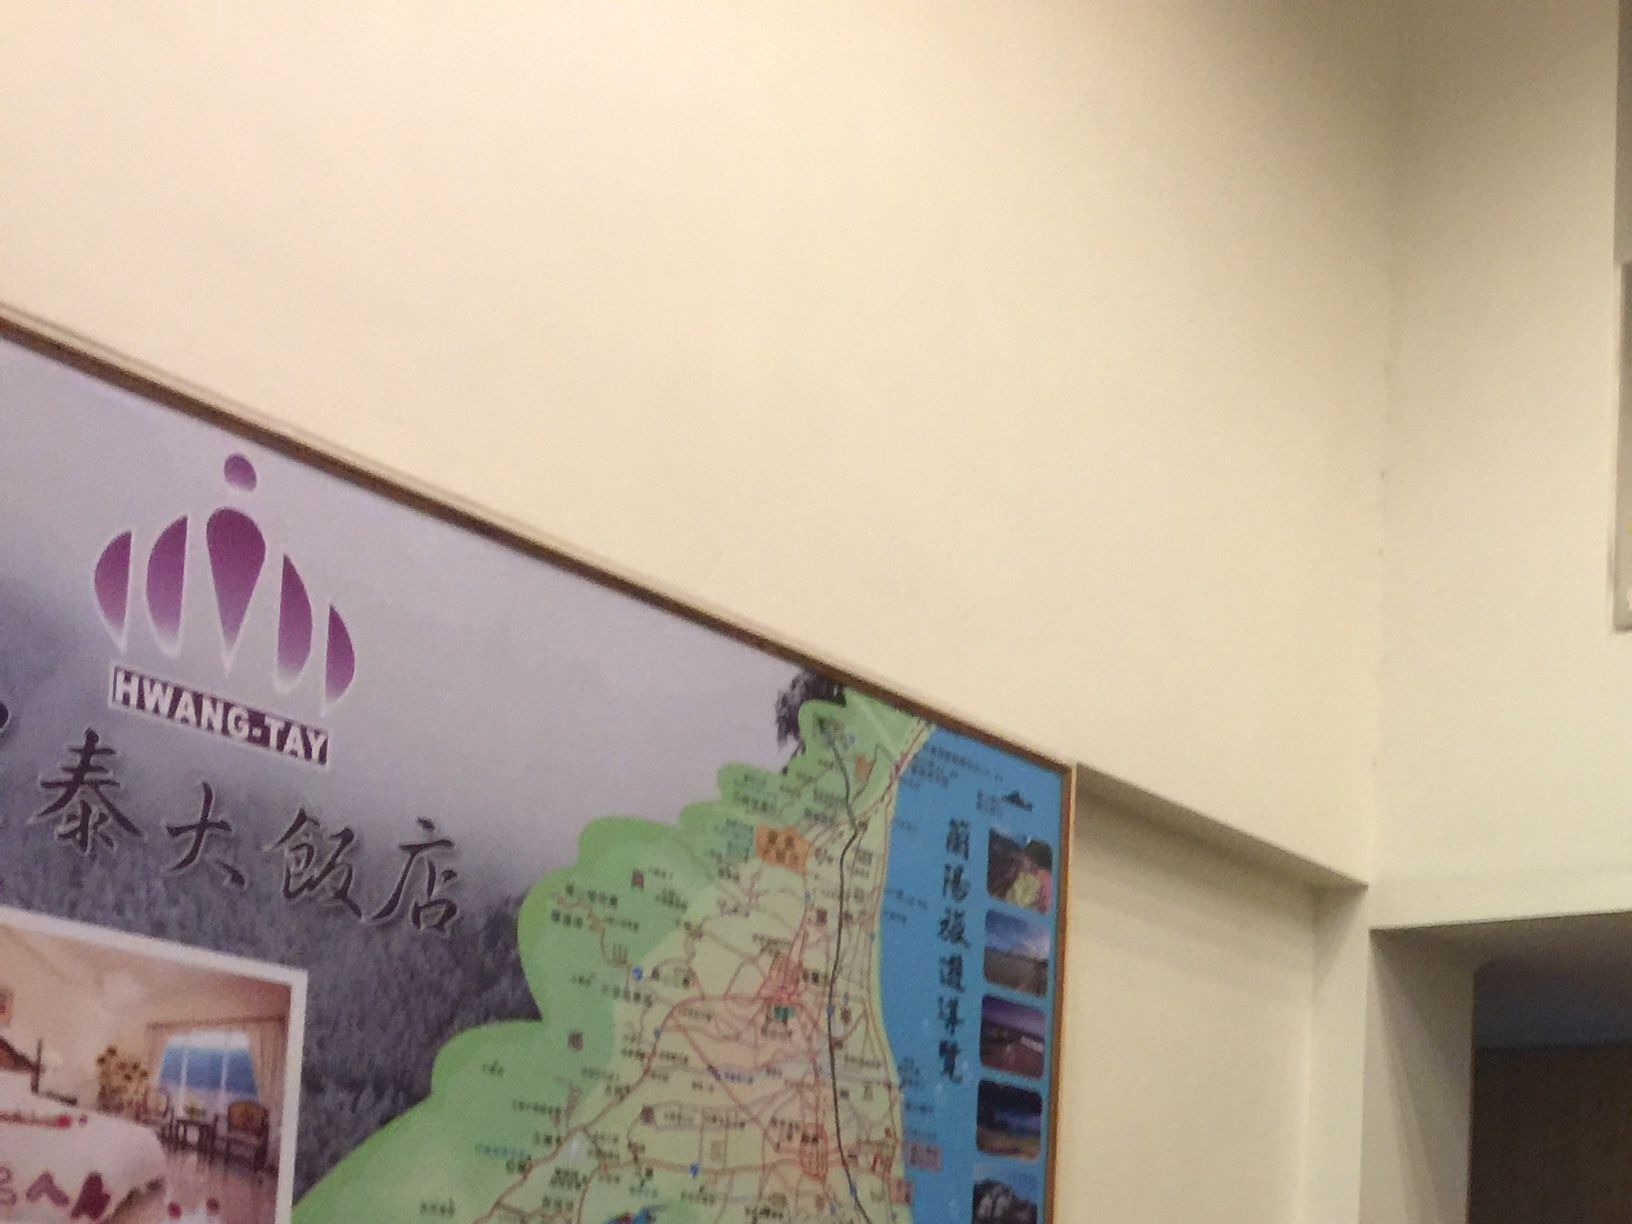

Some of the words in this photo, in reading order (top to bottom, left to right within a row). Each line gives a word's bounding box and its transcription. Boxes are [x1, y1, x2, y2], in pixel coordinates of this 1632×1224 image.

[114, 667, 328, 764] HWANG-TAY
[0, 702, 459, 932] 泰大飯店
